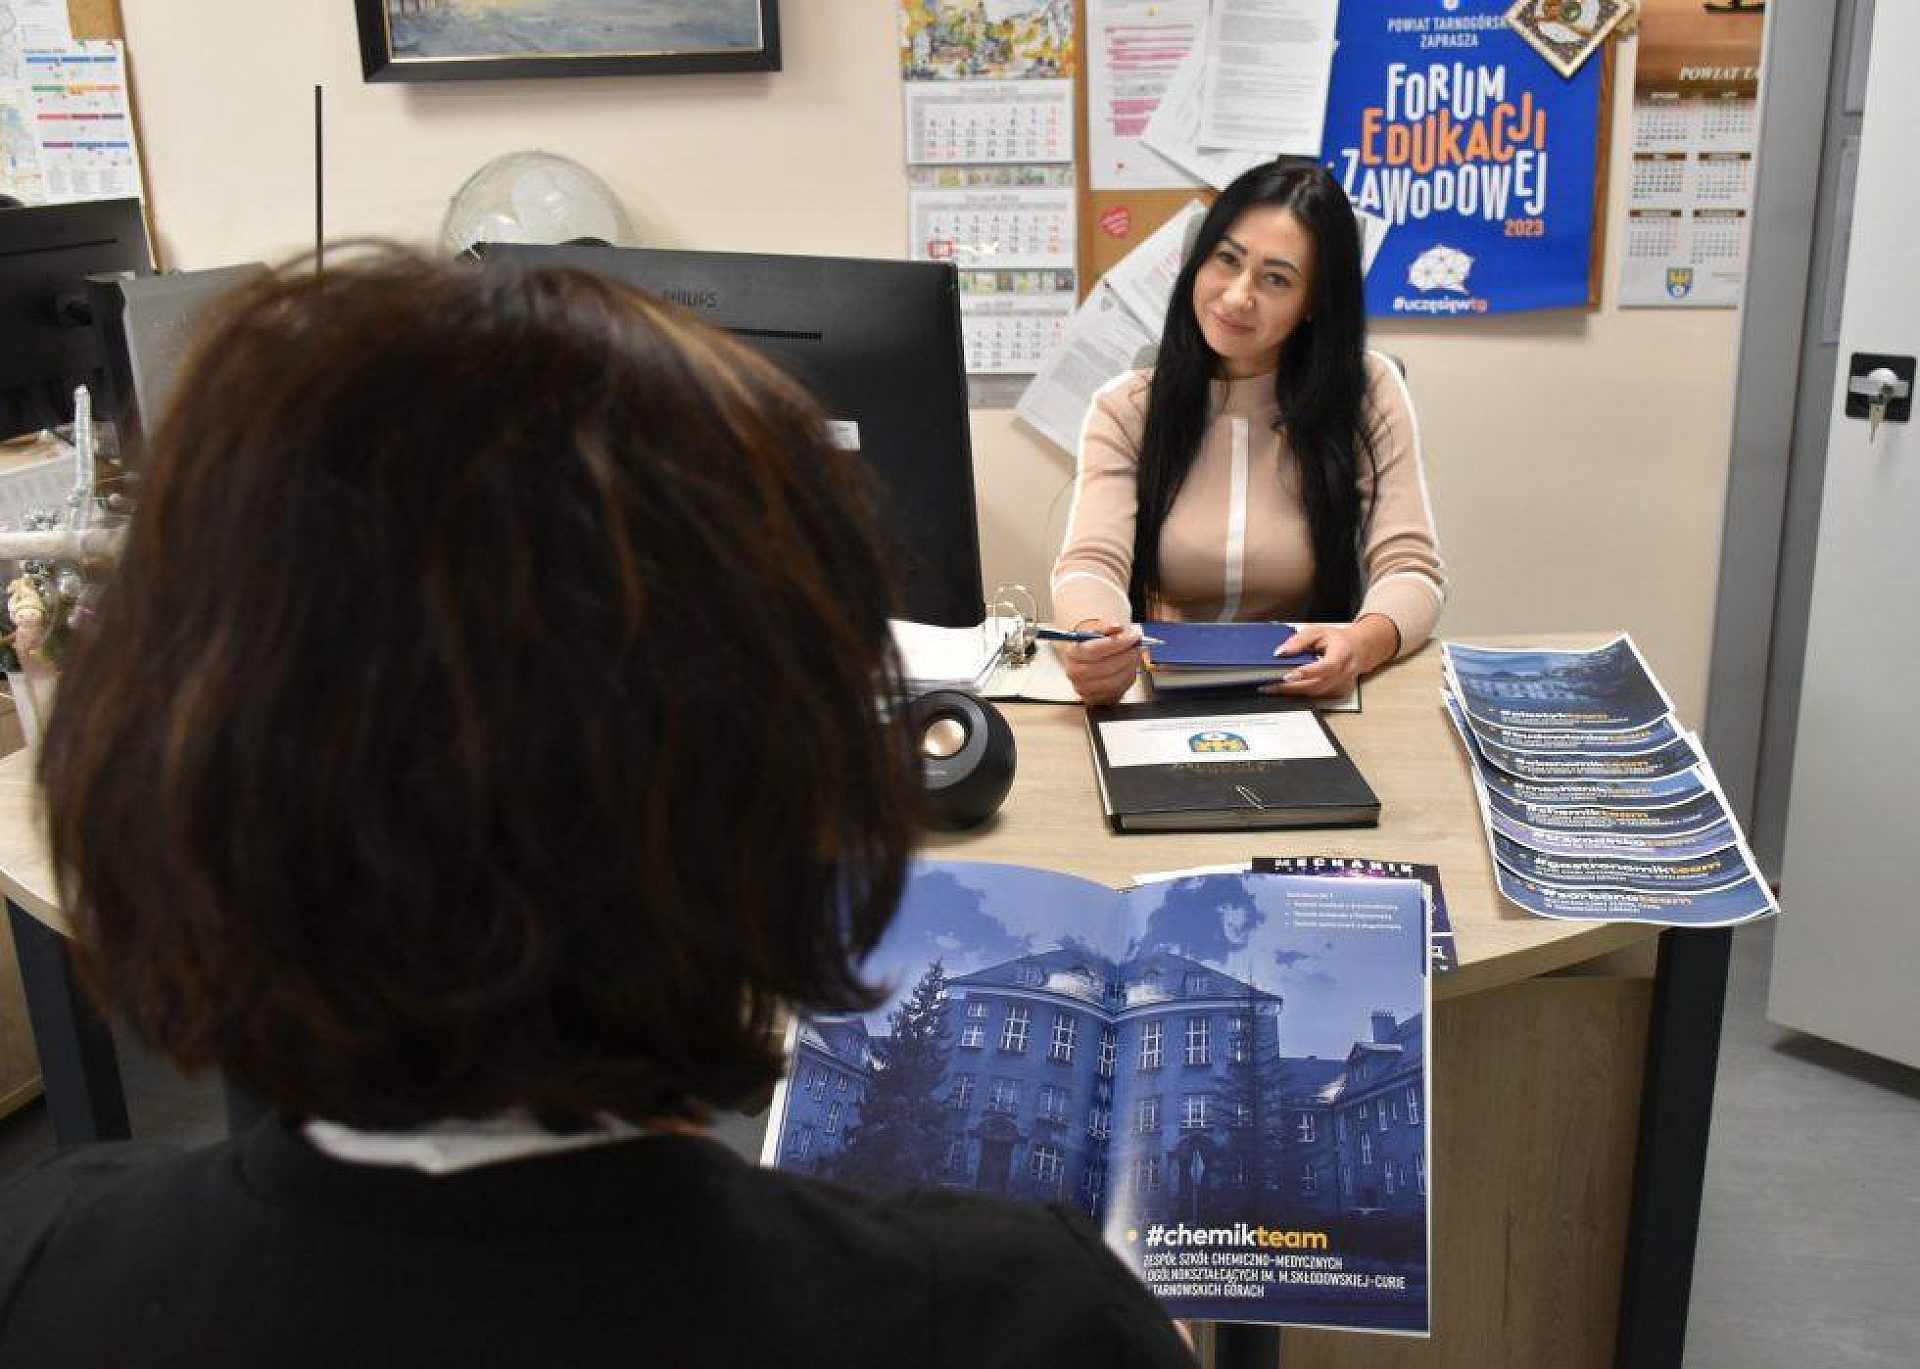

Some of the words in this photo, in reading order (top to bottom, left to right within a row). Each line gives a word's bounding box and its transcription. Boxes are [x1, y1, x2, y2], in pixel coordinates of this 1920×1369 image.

[1420, 32, 1478, 48] ZAPRASZA
[1387, 61, 1505, 122] FORUM
[1361, 92, 1547, 174] EDUKACJI
[1341, 148, 1547, 225] ZAWODOWEJ
[1504, 219, 1545, 237] 2023
[1274, 858, 1413, 874] MECHANIK
[1146, 1222, 1328, 1250] #chemikteam
[1179, 1250, 1209, 1266] SZKÓŁ
[1212, 1252, 1343, 1271] CHEMICZNO-MEDYCZNYCH
[1153, 1284, 1222, 1297] TARNOWSKICH
[1224, 1282, 1265, 1298] GÓRACH
